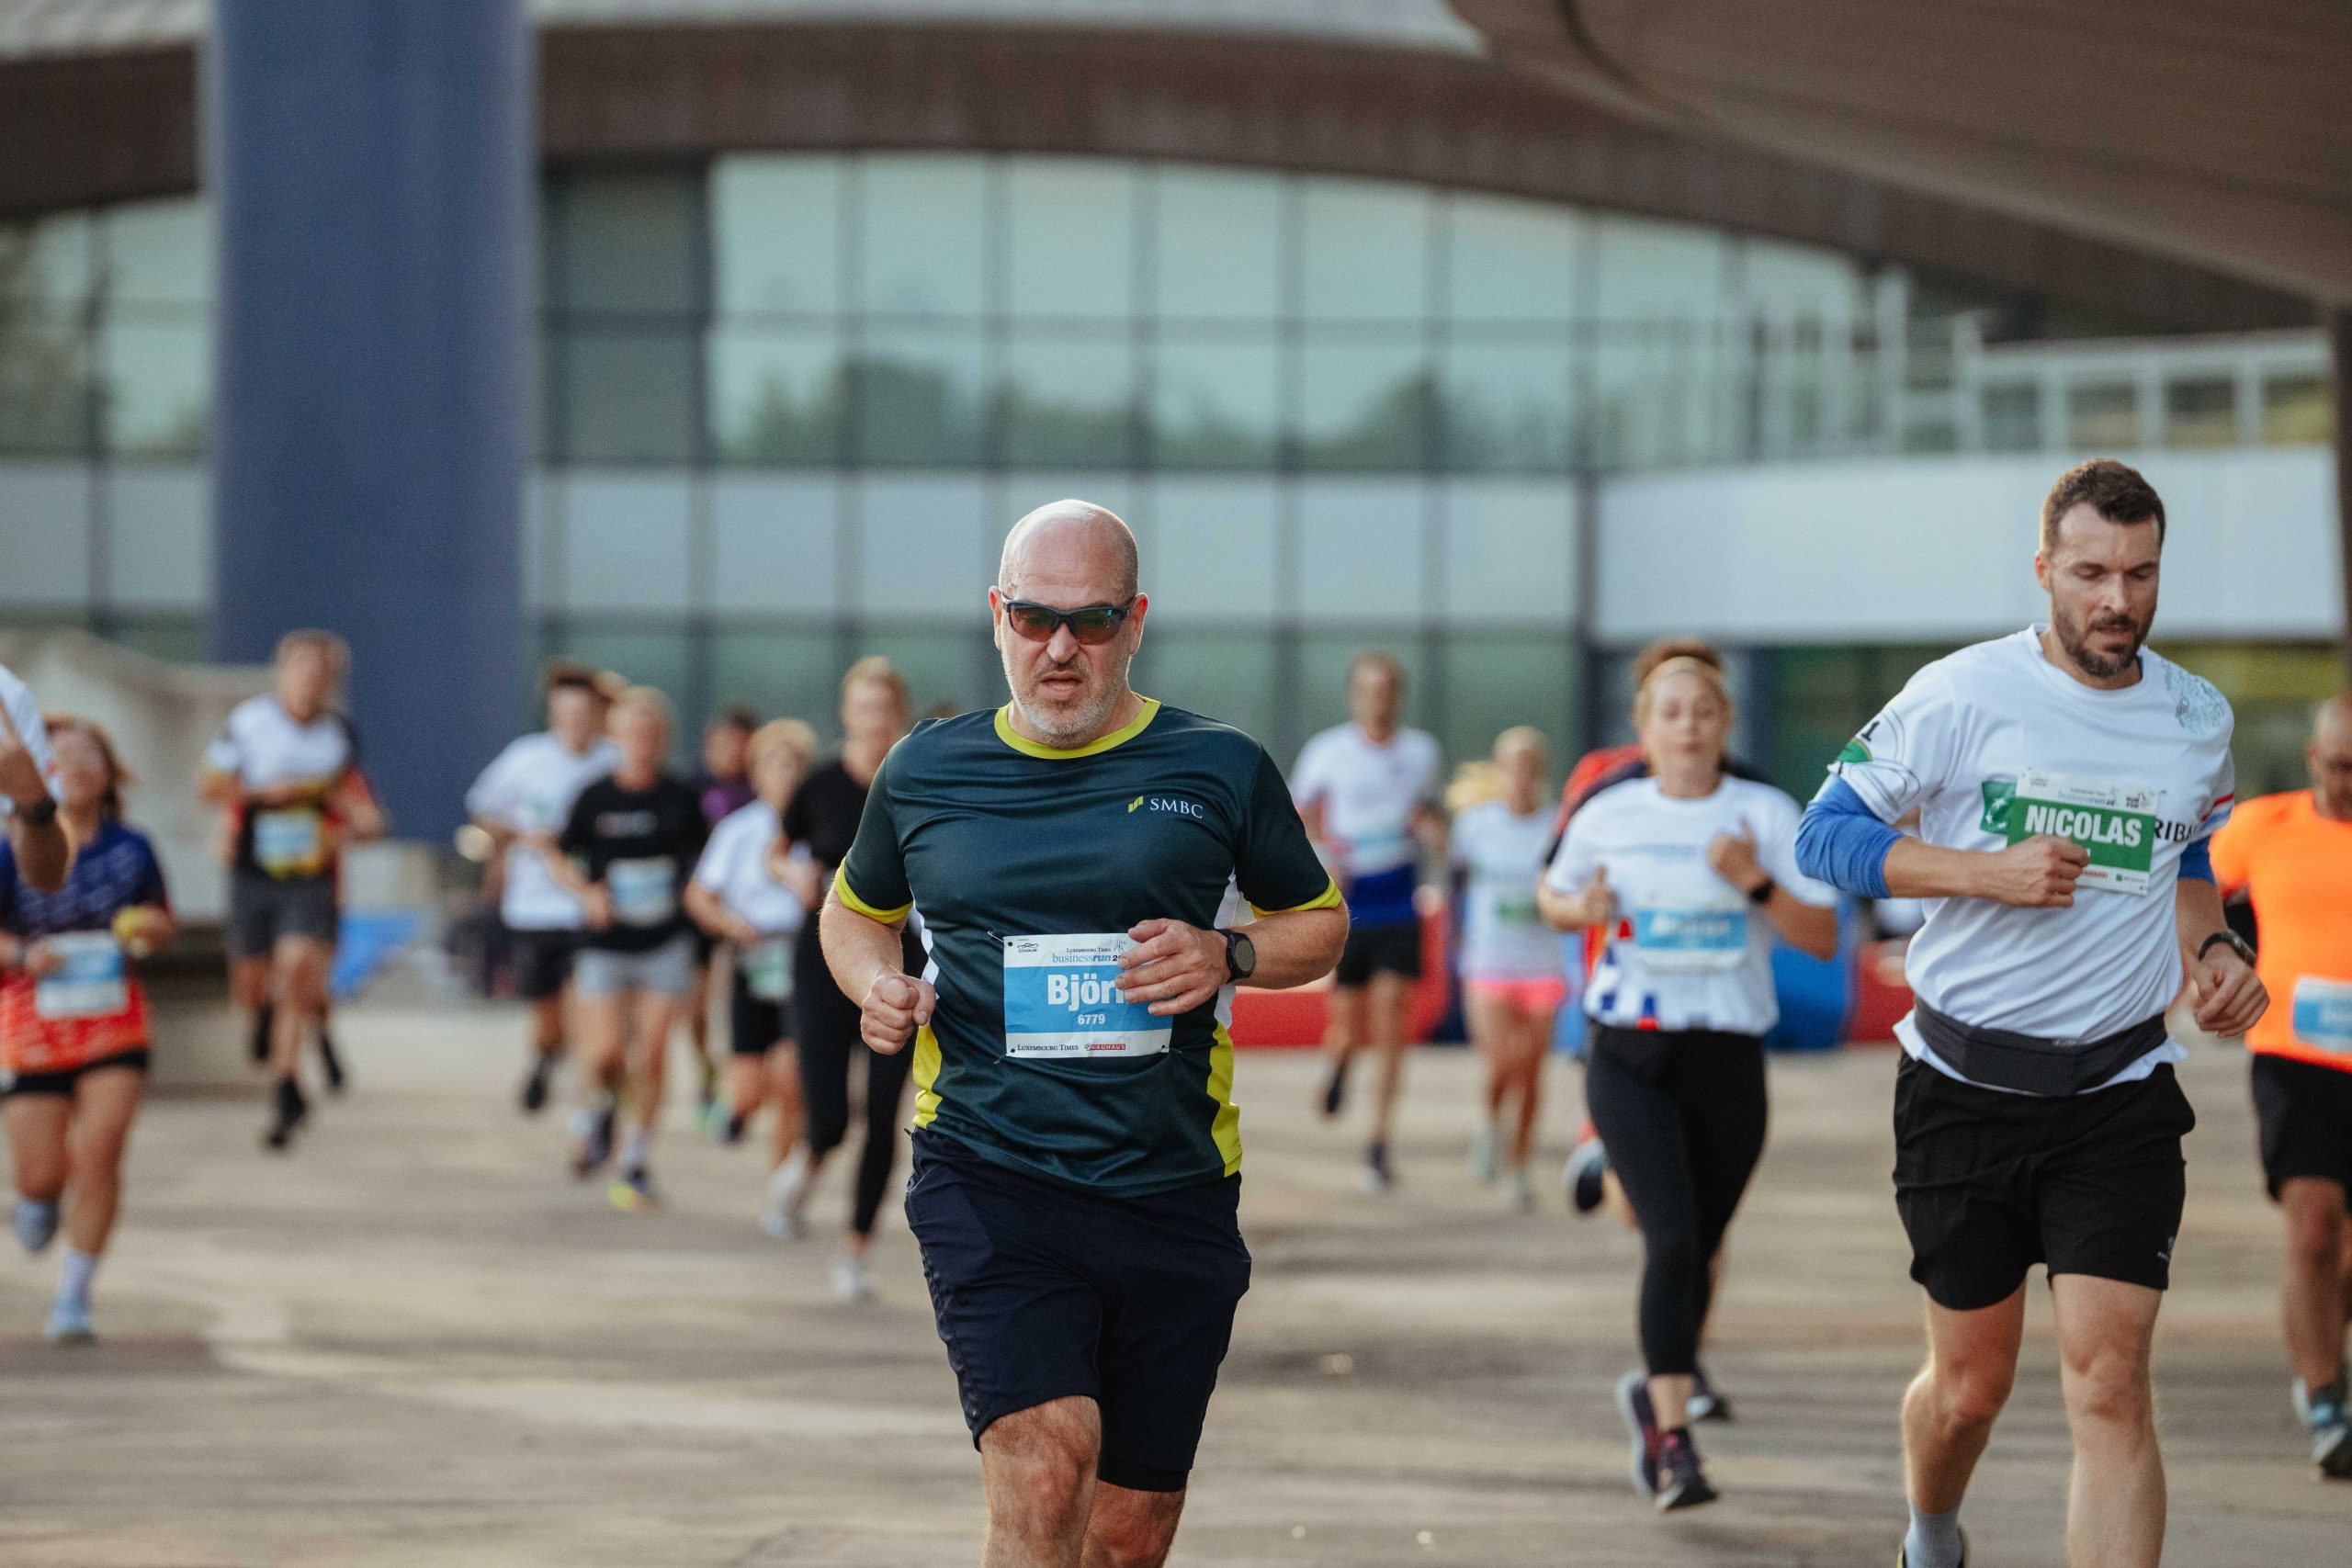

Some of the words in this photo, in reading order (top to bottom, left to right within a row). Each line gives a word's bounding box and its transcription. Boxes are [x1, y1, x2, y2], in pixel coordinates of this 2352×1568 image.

[1149, 797, 1203, 819] SMBC
[2025, 804, 2143, 848] NICOLAS
[1052, 953, 1111, 964] businessrun
[1077, 1013, 1106, 1025] 6779
